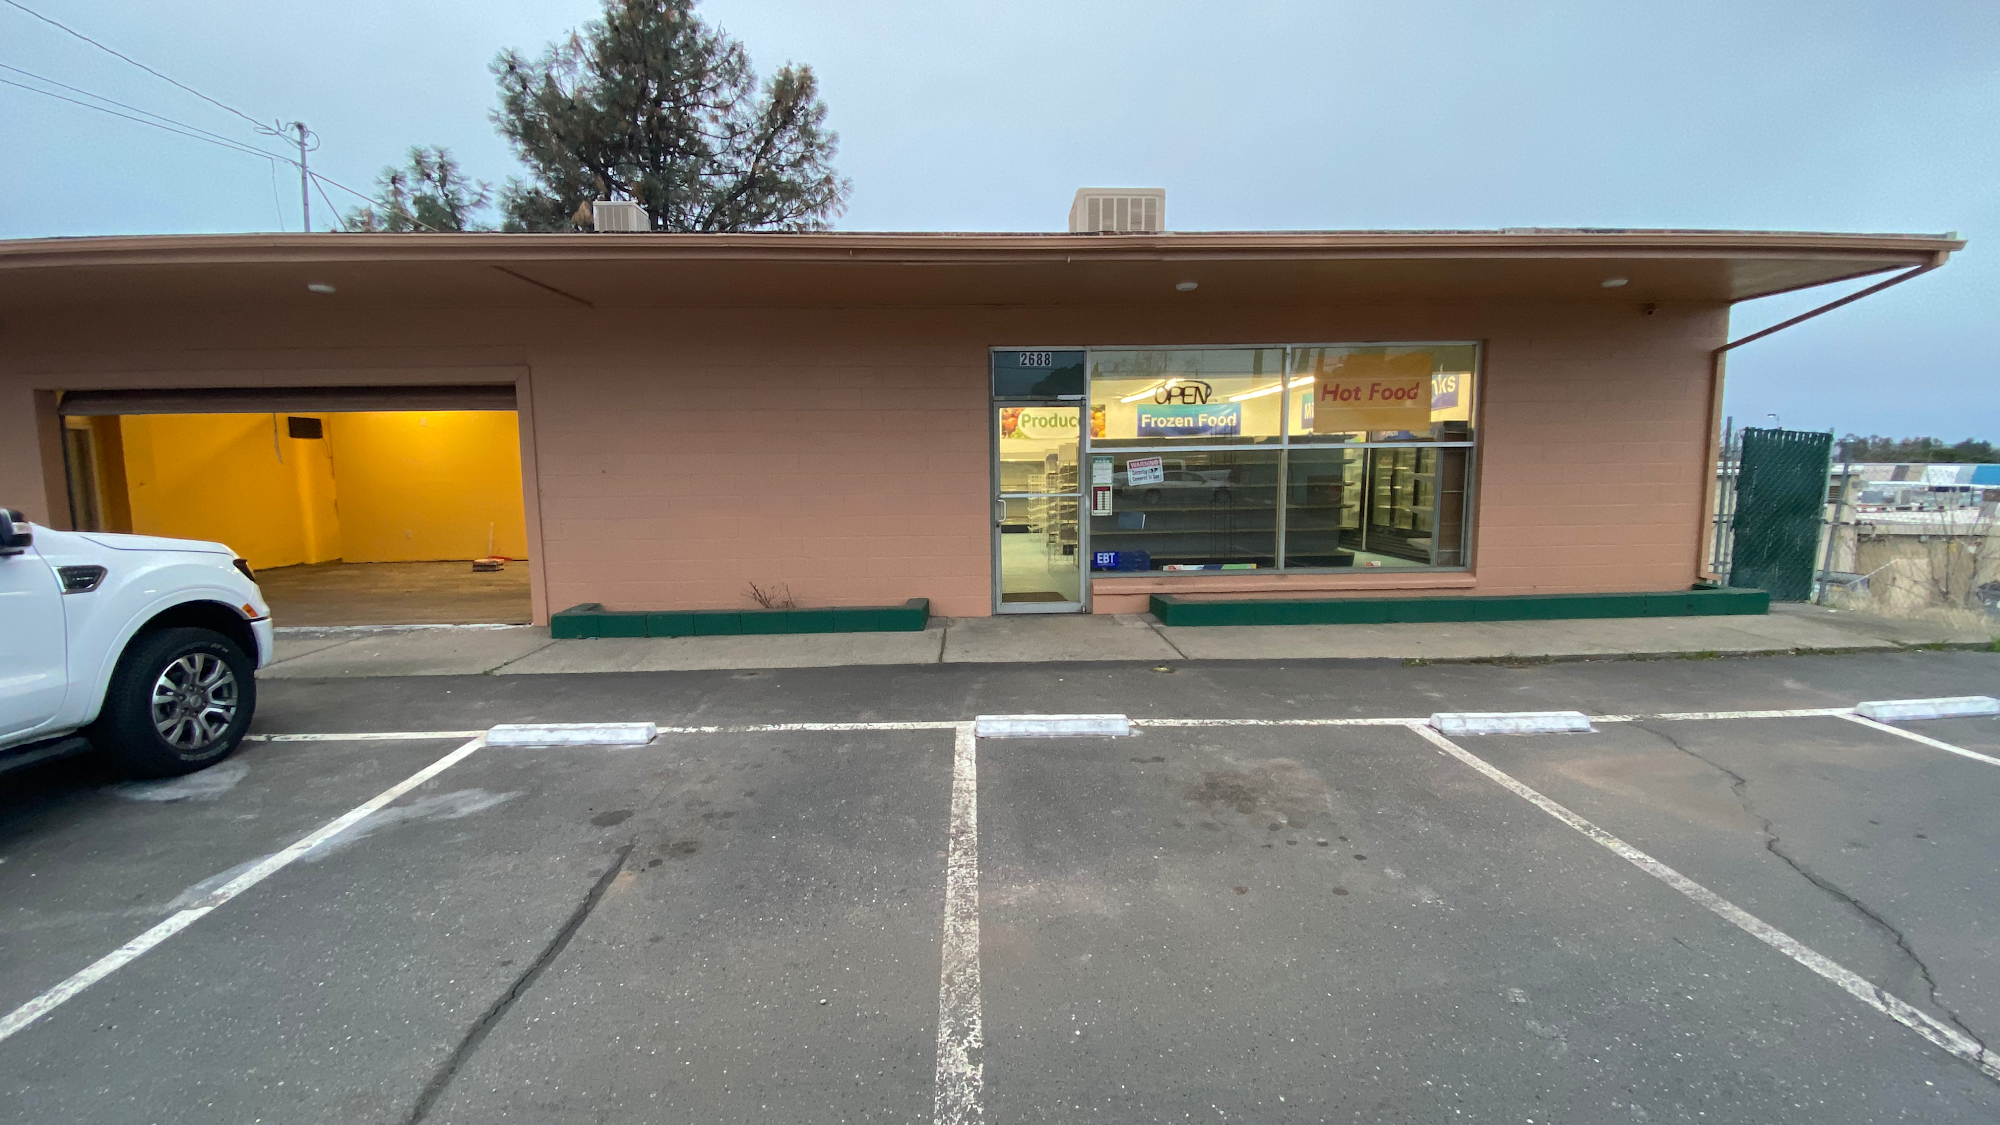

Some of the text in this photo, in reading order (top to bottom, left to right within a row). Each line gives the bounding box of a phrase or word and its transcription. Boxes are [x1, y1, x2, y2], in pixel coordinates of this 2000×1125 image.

[1020, 353, 1051, 366] 2688
[1321, 382, 1420, 402] Hot Food
[1432, 374, 1456, 395] nks
[1154, 386, 1208, 405] OPEN
[1021, 413, 1080, 428] Produc
[1141, 412, 1237, 428] Frozen Food
[1130, 459, 1159, 468] WARNING
[1096, 552, 1116, 564] EBT
